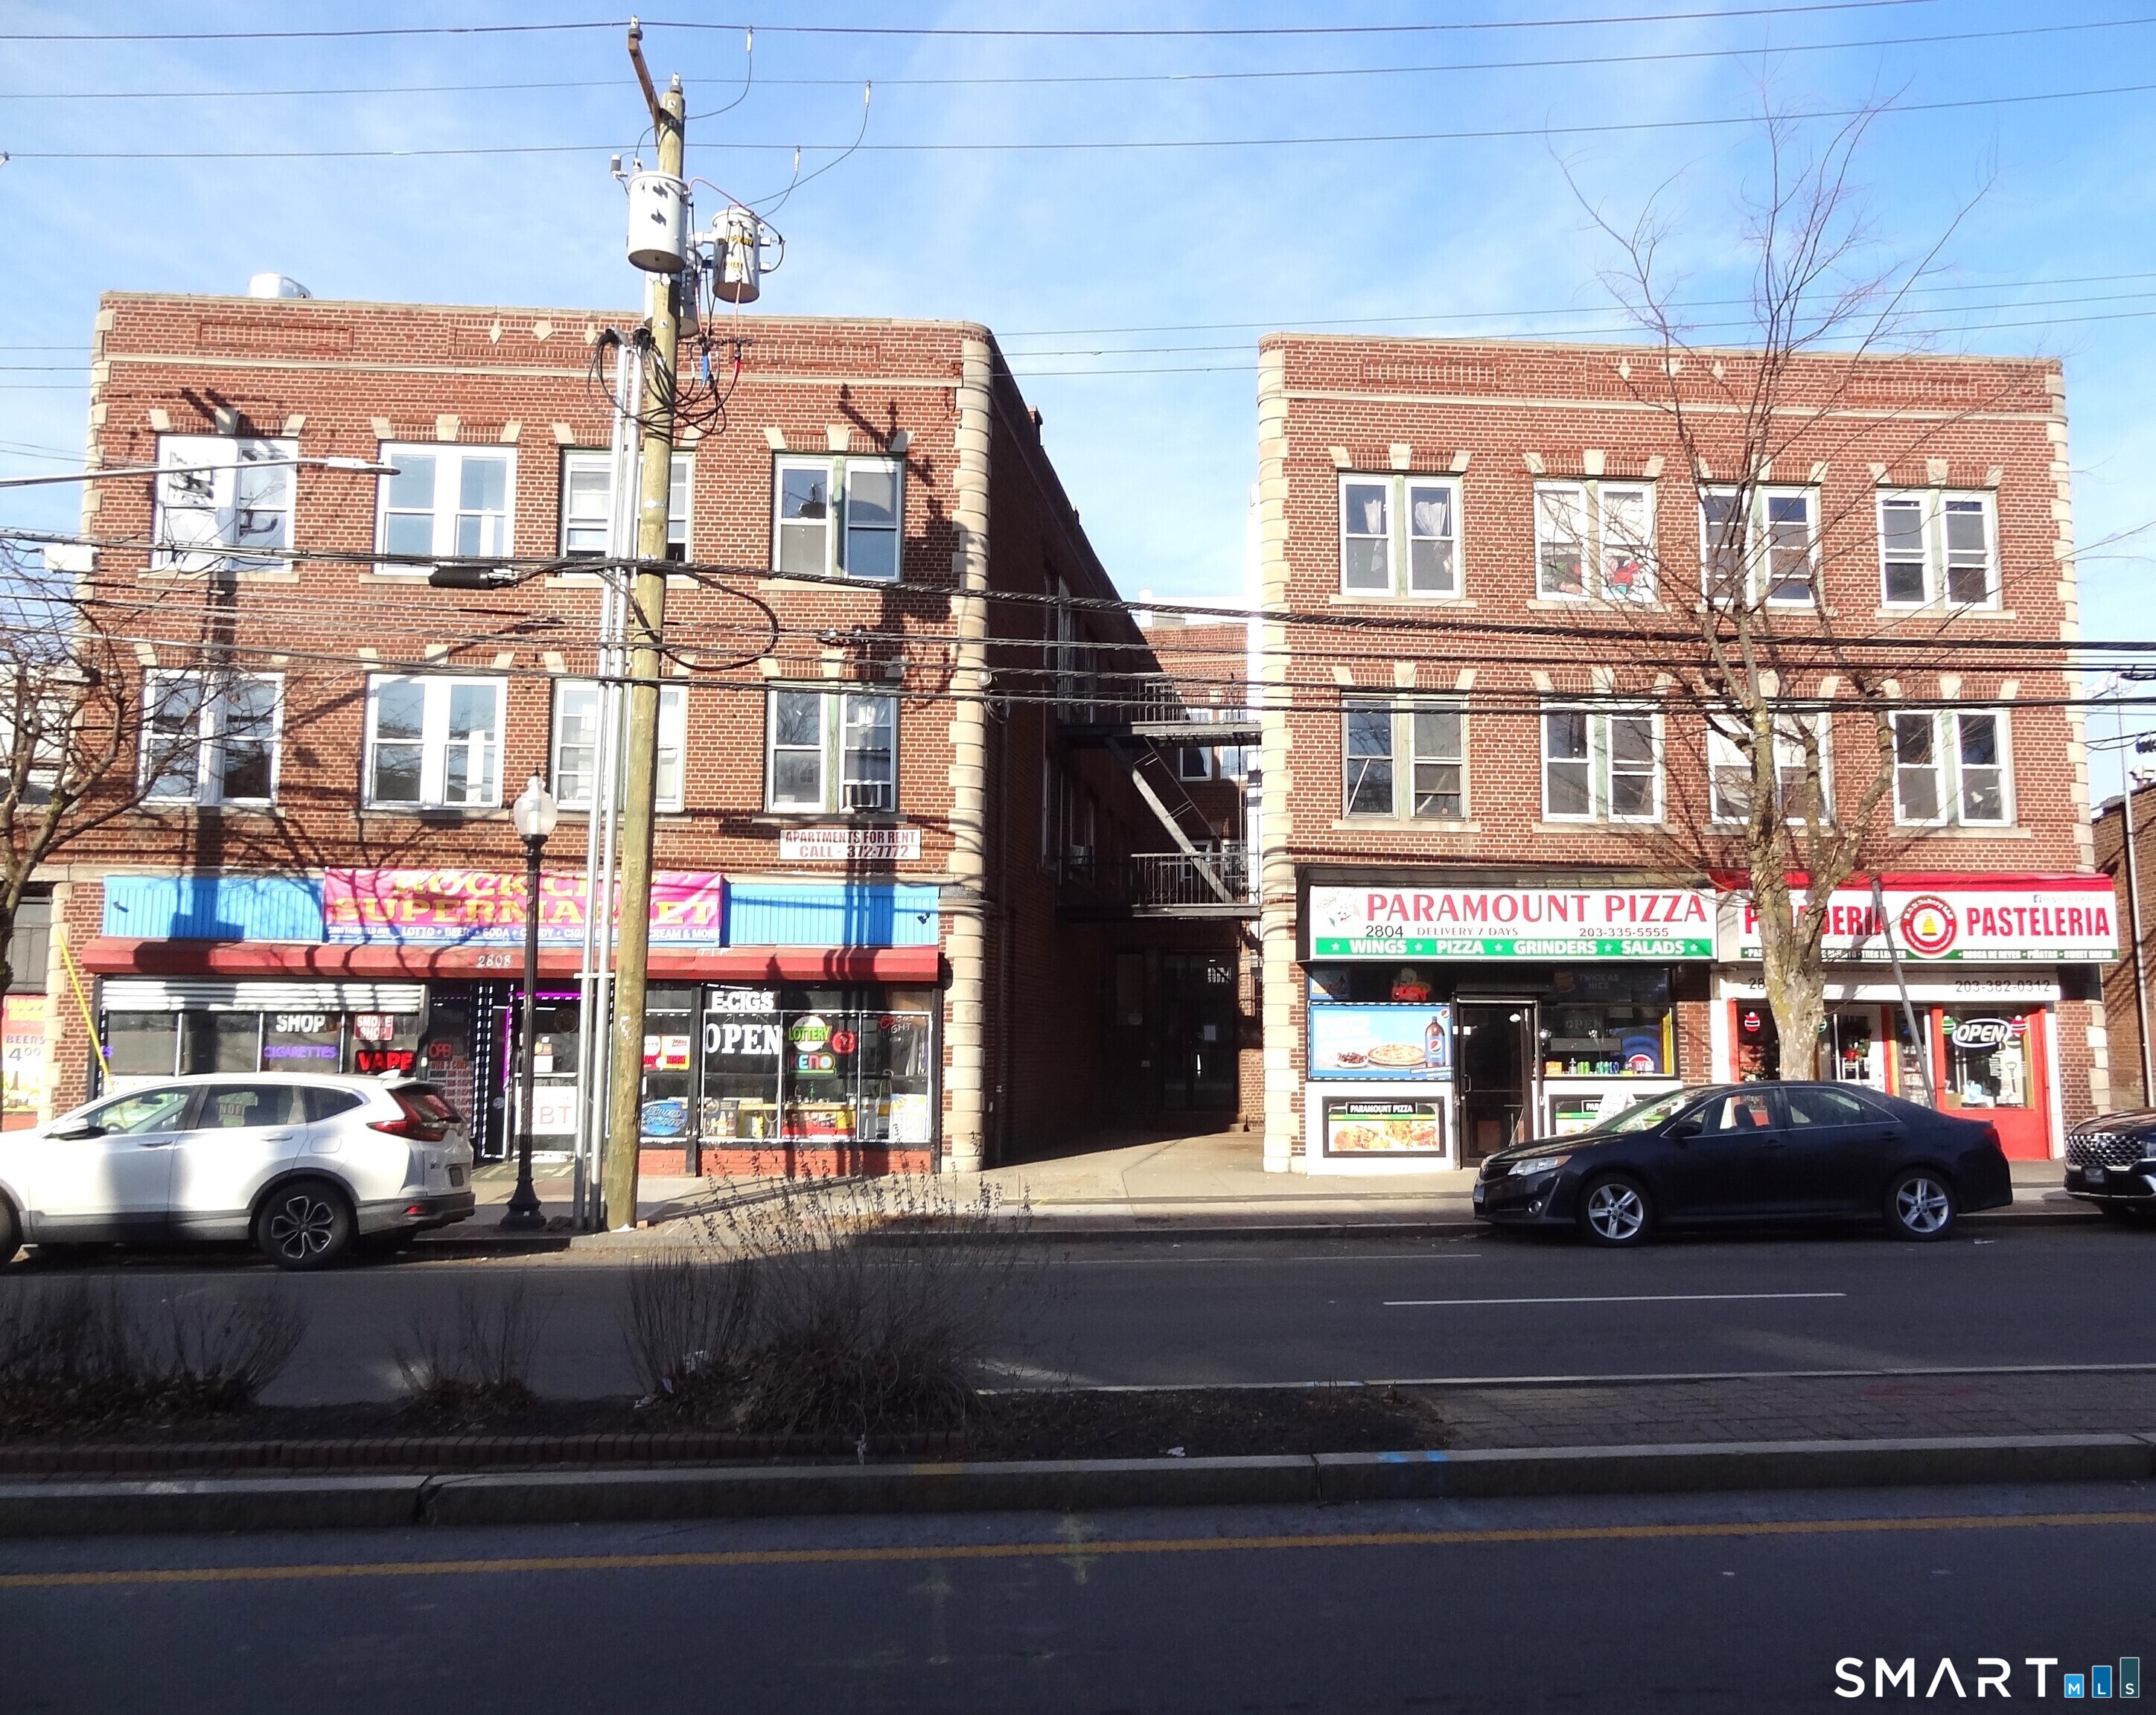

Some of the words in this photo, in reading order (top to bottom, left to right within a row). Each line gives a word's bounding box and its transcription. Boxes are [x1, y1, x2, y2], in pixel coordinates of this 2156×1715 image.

[785, 831, 861, 843] APARTMENTS
[864, 831, 884, 843] FOR
[887, 831, 916, 843] RENT
[800, 846, 833, 858] CALL
[846, 846, 909, 858] 372-7772
[334, 897, 720, 925] SUPERMARET
[1367, 894, 1591, 923] PARAMOUNT
[1604, 894, 1708, 923] PIZZA
[1744, 905, 1886, 936] PERIA
[1966, 907, 2110, 936] PASTELERIA
[401, 925, 434, 937] LOTTO
[444, 927, 470, 937] BEER
[482, 927, 510, 938] SODA
[520, 927, 555, 938] CDY
[683, 929, 691, 938] &
[692, 929, 721, 939] MORE
[1365, 925, 1404, 938] 2804
[1417, 927, 1473, 936] DELIVERY
[1489, 927, 1518, 936] DAYS
[1579, 927, 1669, 937] 203-335-5555
[1349, 939, 1408, 954] WINGS
[1435, 939, 1485, 954] PIZZA
[1513, 940, 1598, 955] GRINDERS
[1620, 940, 1686, 955] SALADS
[476, 954, 511, 968] 2808
[1880, 951, 1907, 959] LECES
[1749, 977, 1765, 990] 28
[1955, 980, 2051, 993] 203-382-0312
[711, 991, 774, 1010] E-CIGS
[276, 1015, 325, 1033] SHOP
[357, 1015, 392, 1028] SMOKE
[360, 1026, 387, 1038] SHOP
[705, 1023, 782, 1055] OPEN
[788, 1025, 832, 1042] LOTTERY
[1956, 1023, 2006, 1043] OPEN
[6, 1035, 45, 1044] BEERS
[264, 1045, 338, 1059] CIGARETTES
[358, 1052, 414, 1071] VAPE
[532, 1106, 572, 1125] BT
[1350, 1105, 1392, 1114] PARAMOUNT
[1393, 1105, 1413, 1114] PIZZA
